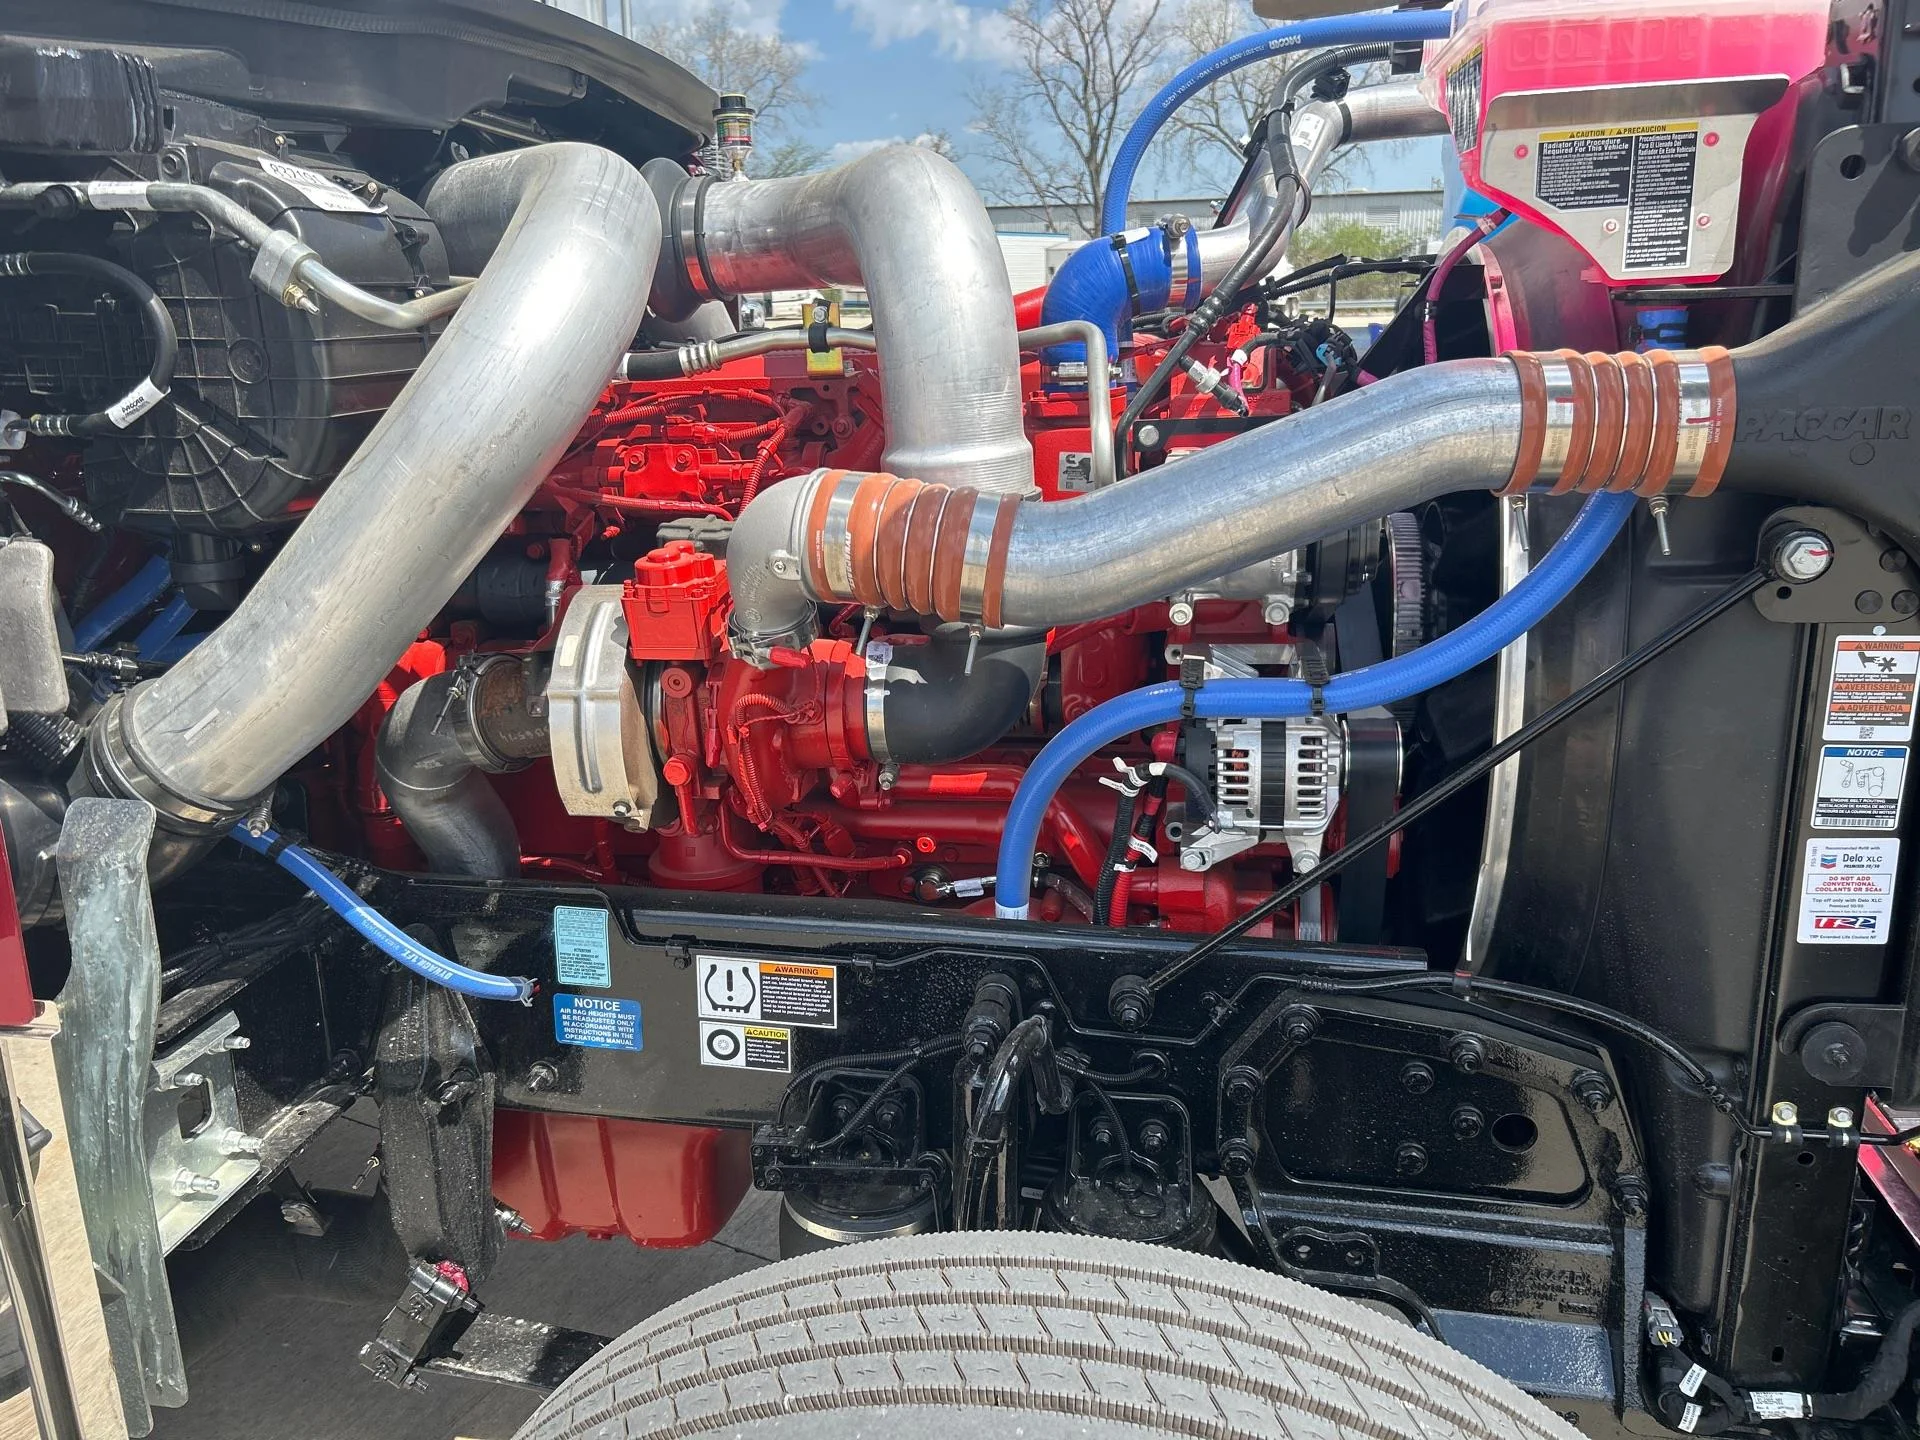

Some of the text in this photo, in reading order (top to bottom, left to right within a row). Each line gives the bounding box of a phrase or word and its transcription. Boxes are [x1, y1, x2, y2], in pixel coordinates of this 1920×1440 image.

[1624, 126, 1666, 134] PRECAUCION
[1544, 140, 1571, 149] Radiator
[1543, 147, 1572, 155] Required
[1843, 854, 1863, 862] Delo
[782, 966, 818, 975] WARNING
[574, 998, 621, 1011] NOTICE
[572, 1015, 615, 1024] READJUSTED
[571, 1022, 616, 1031] ACCORDANCE
[564, 1027, 611, 1037] INSTRUCTIONS
[753, 1030, 787, 1038] CAUTION
[565, 1034, 604, 1042] OPERATORS
[606, 1037, 633, 1045] MANUAL
